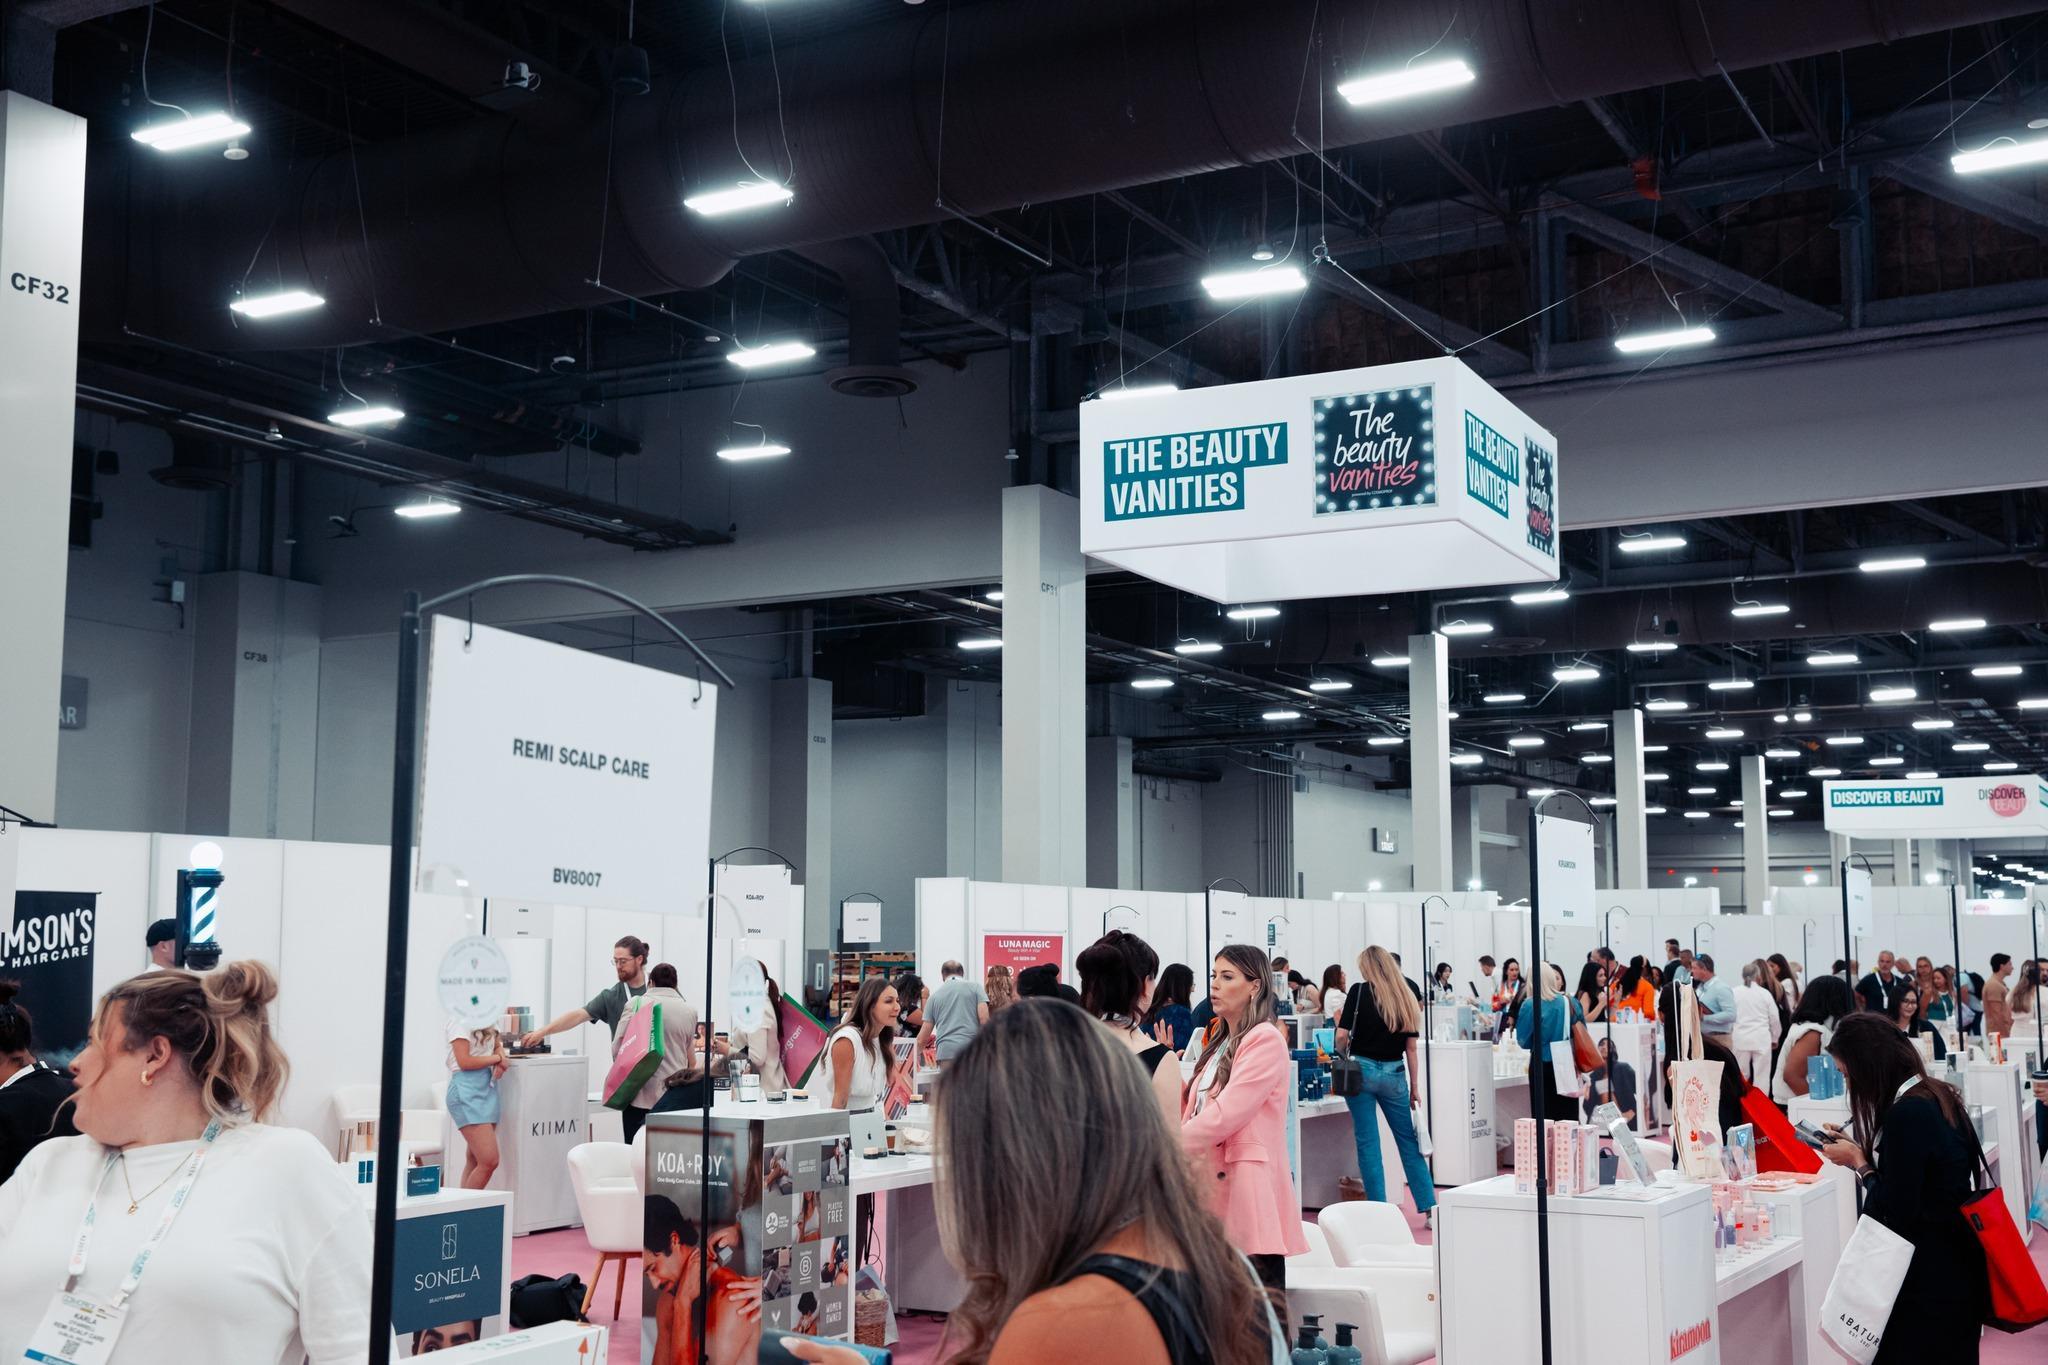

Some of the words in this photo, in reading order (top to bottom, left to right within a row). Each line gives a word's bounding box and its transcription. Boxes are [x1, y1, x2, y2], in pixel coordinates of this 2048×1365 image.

[11, 272, 69, 304] CF32
[1349, 402, 1394, 438] The
[1110, 439, 1163, 474] THE
[1170, 426, 1281, 469] BEAUTY
[1333, 431, 1413, 468] beauty
[1467, 413, 1484, 457] THE
[1486, 428, 1518, 479] BEAUTY
[1329, 460, 1419, 493] vanities
[1468, 456, 1507, 513] VANITIES
[1533, 457, 1545, 485] The
[1111, 471, 1238, 515] VANITIES
[513, 738, 554, 762] REMI
[559, 746, 607, 770] SCALP
[612, 756, 650, 779] CARE
[1833, 790, 1892, 805] DISCOVER
[1894, 788, 1942, 804] BEAUTY
[1979, 787, 2026, 800] DISCOVER
[553, 868, 602, 888] BV8007
[12, 945, 89, 968] HAIRCARE
[999, 940, 1021, 948] LUNA
[1022, 940, 1051, 948] MAGIC
[827, 1201, 843, 1210] PLASTIC
[827, 1209, 843, 1224] FREE
[414, 1264, 480, 1291] SONELA
[826, 1301, 842, 1313] WOMEN
[826, 1312, 841, 1323] OWNED
[1670, 1318, 1711, 1361] kiramoon
[1840, 1313, 1880, 1346] ABATUR
